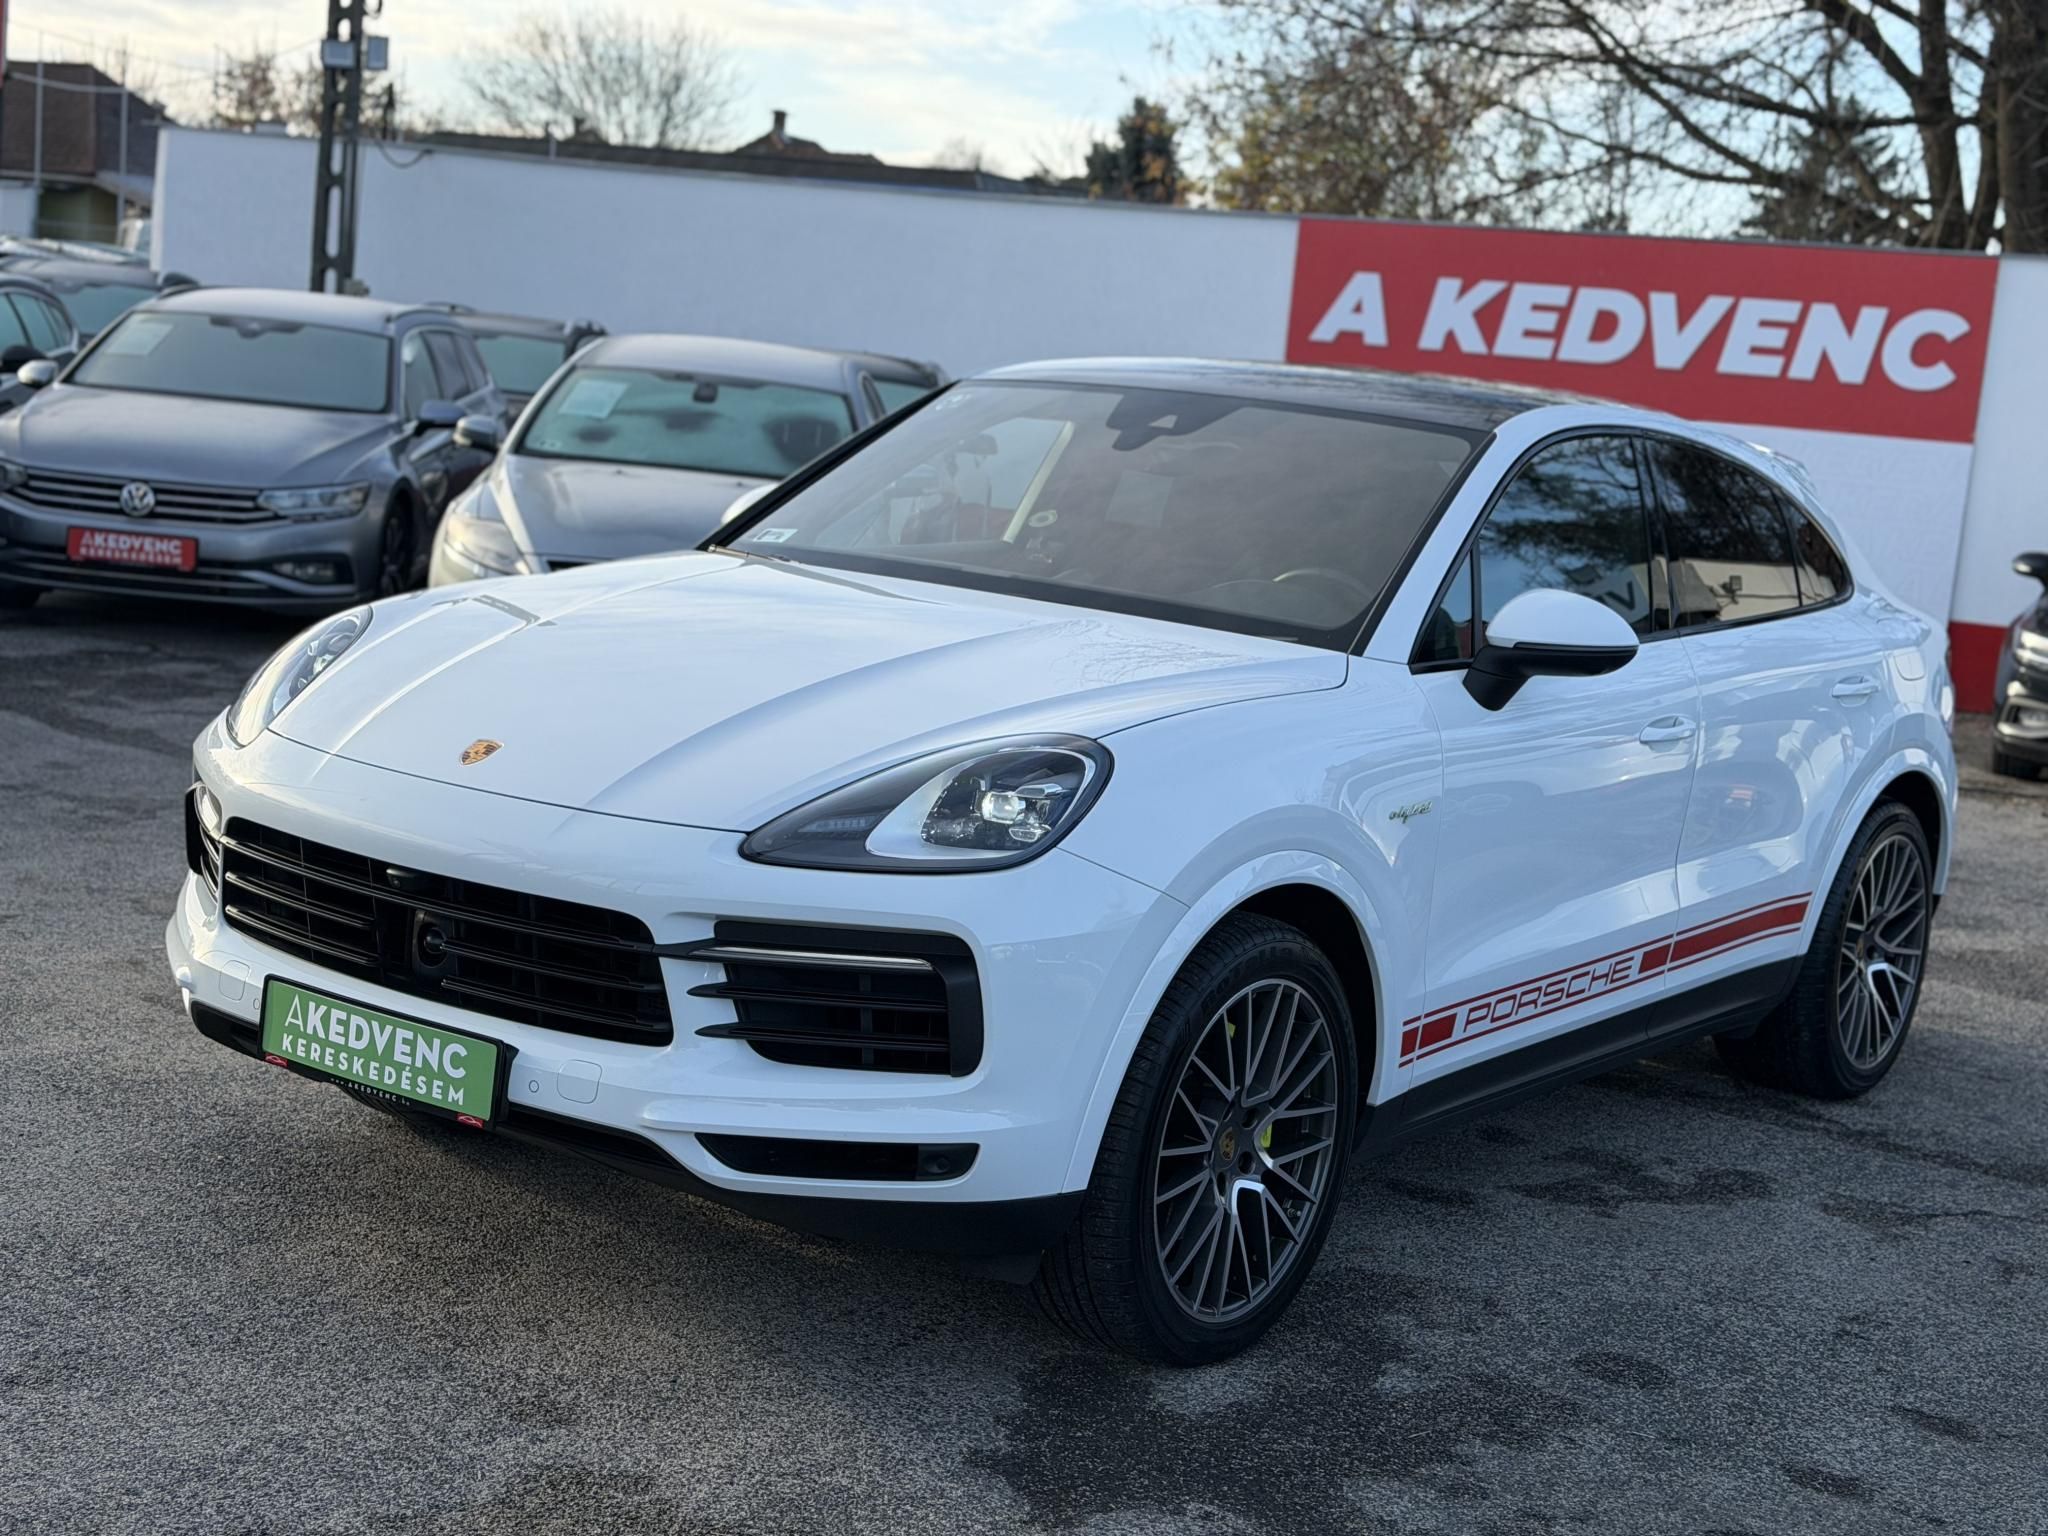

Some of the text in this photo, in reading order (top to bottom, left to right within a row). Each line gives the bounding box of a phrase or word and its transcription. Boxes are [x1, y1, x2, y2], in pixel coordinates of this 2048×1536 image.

[1308, 271, 1972, 392] A KEDVENC
[1463, 956, 1635, 1033] PORSCHE
[281, 1032, 465, 1106] KERESKEDÉSEM
